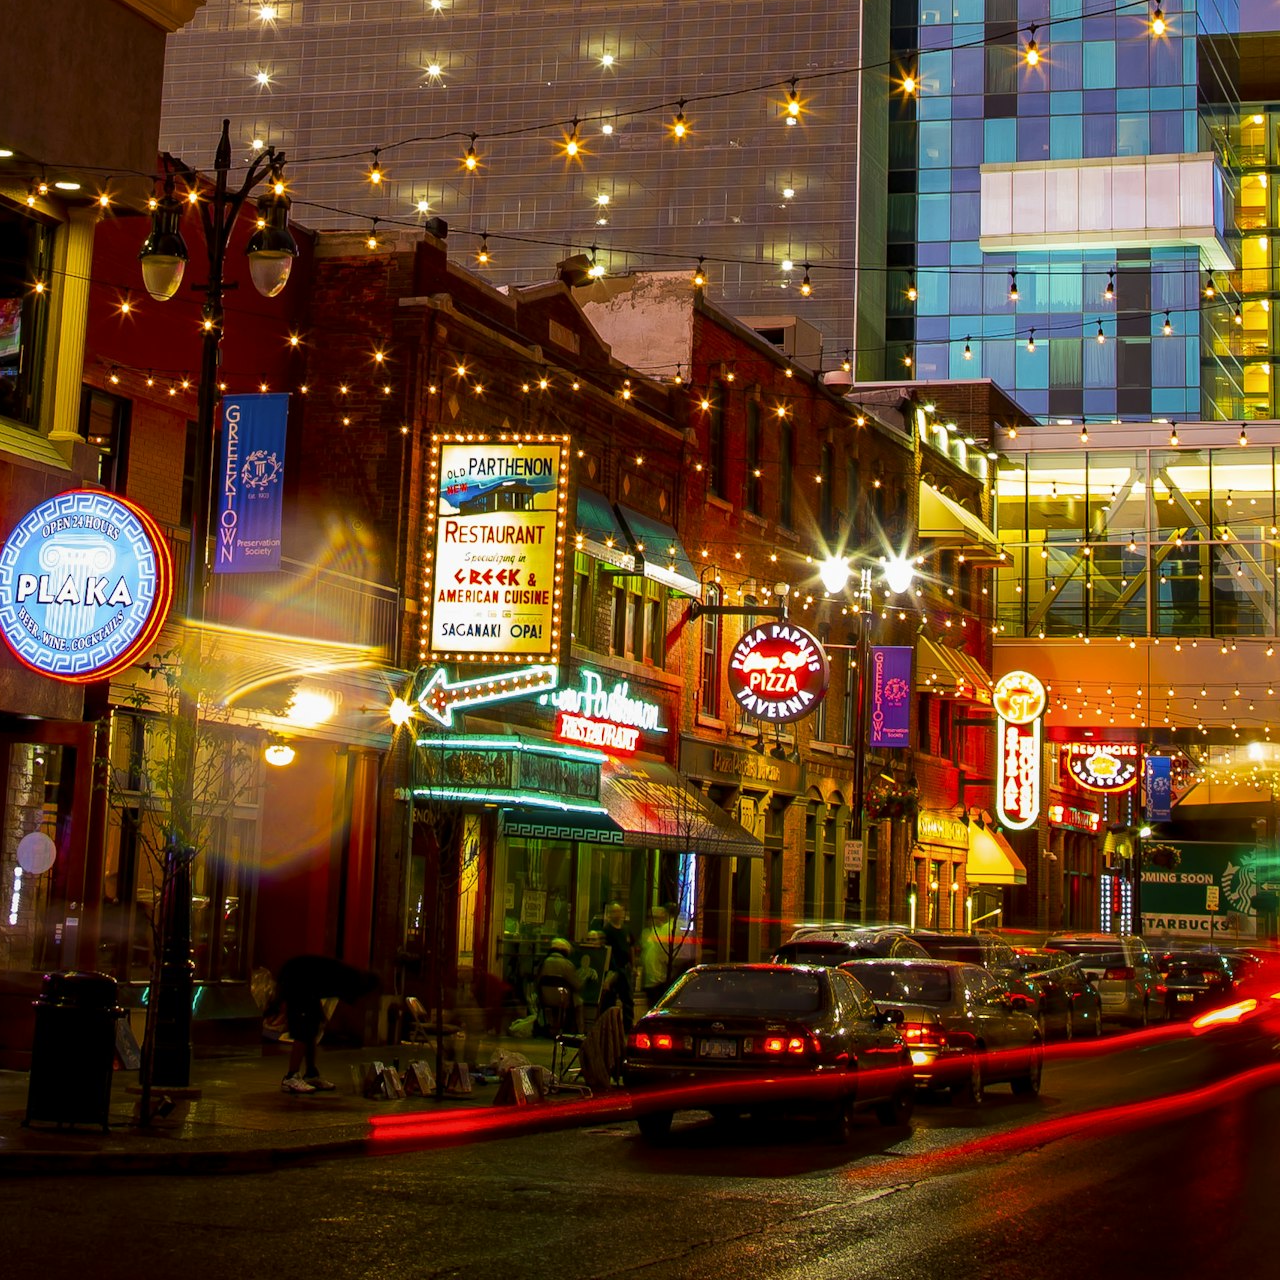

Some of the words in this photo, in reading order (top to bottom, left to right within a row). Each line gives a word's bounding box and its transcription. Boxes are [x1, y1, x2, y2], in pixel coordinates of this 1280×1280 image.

[446, 468, 466, 480] OLD
[468, 457, 553, 476] PARTHENON
[220, 404, 240, 564] GREEKTOWN
[446, 483, 469, 495] NEW
[42, 516, 71, 538] OPEN
[72, 514, 84, 529] 24
[85, 515, 120, 541] HOURS
[444, 520, 546, 545] RESTAURANT
[237, 539, 280, 548] Preservation
[244, 547, 272, 557] Society
[518, 551, 526, 563] in
[453, 568, 521, 587] GREEK
[527, 572, 537, 587] &
[15, 573, 133, 607] PLAKA
[438, 589, 499, 604] AMERICAN
[504, 589, 550, 605] CUISINE
[71, 610, 125, 652] COCKTAILS
[441, 623, 501, 638] SAGANAKI
[510, 623, 543, 639] OPA!
[731, 628, 767, 670] PIZZA
[749, 672, 799, 693] PIZZA
[736, 685, 815, 718] TAVERNA
[872, 651, 884, 741] GREEKTOWN
[560, 714, 640, 752] RESTAURANT
[1141, 872, 1177, 884] OMING
[1180, 873, 1214, 885] SOON
